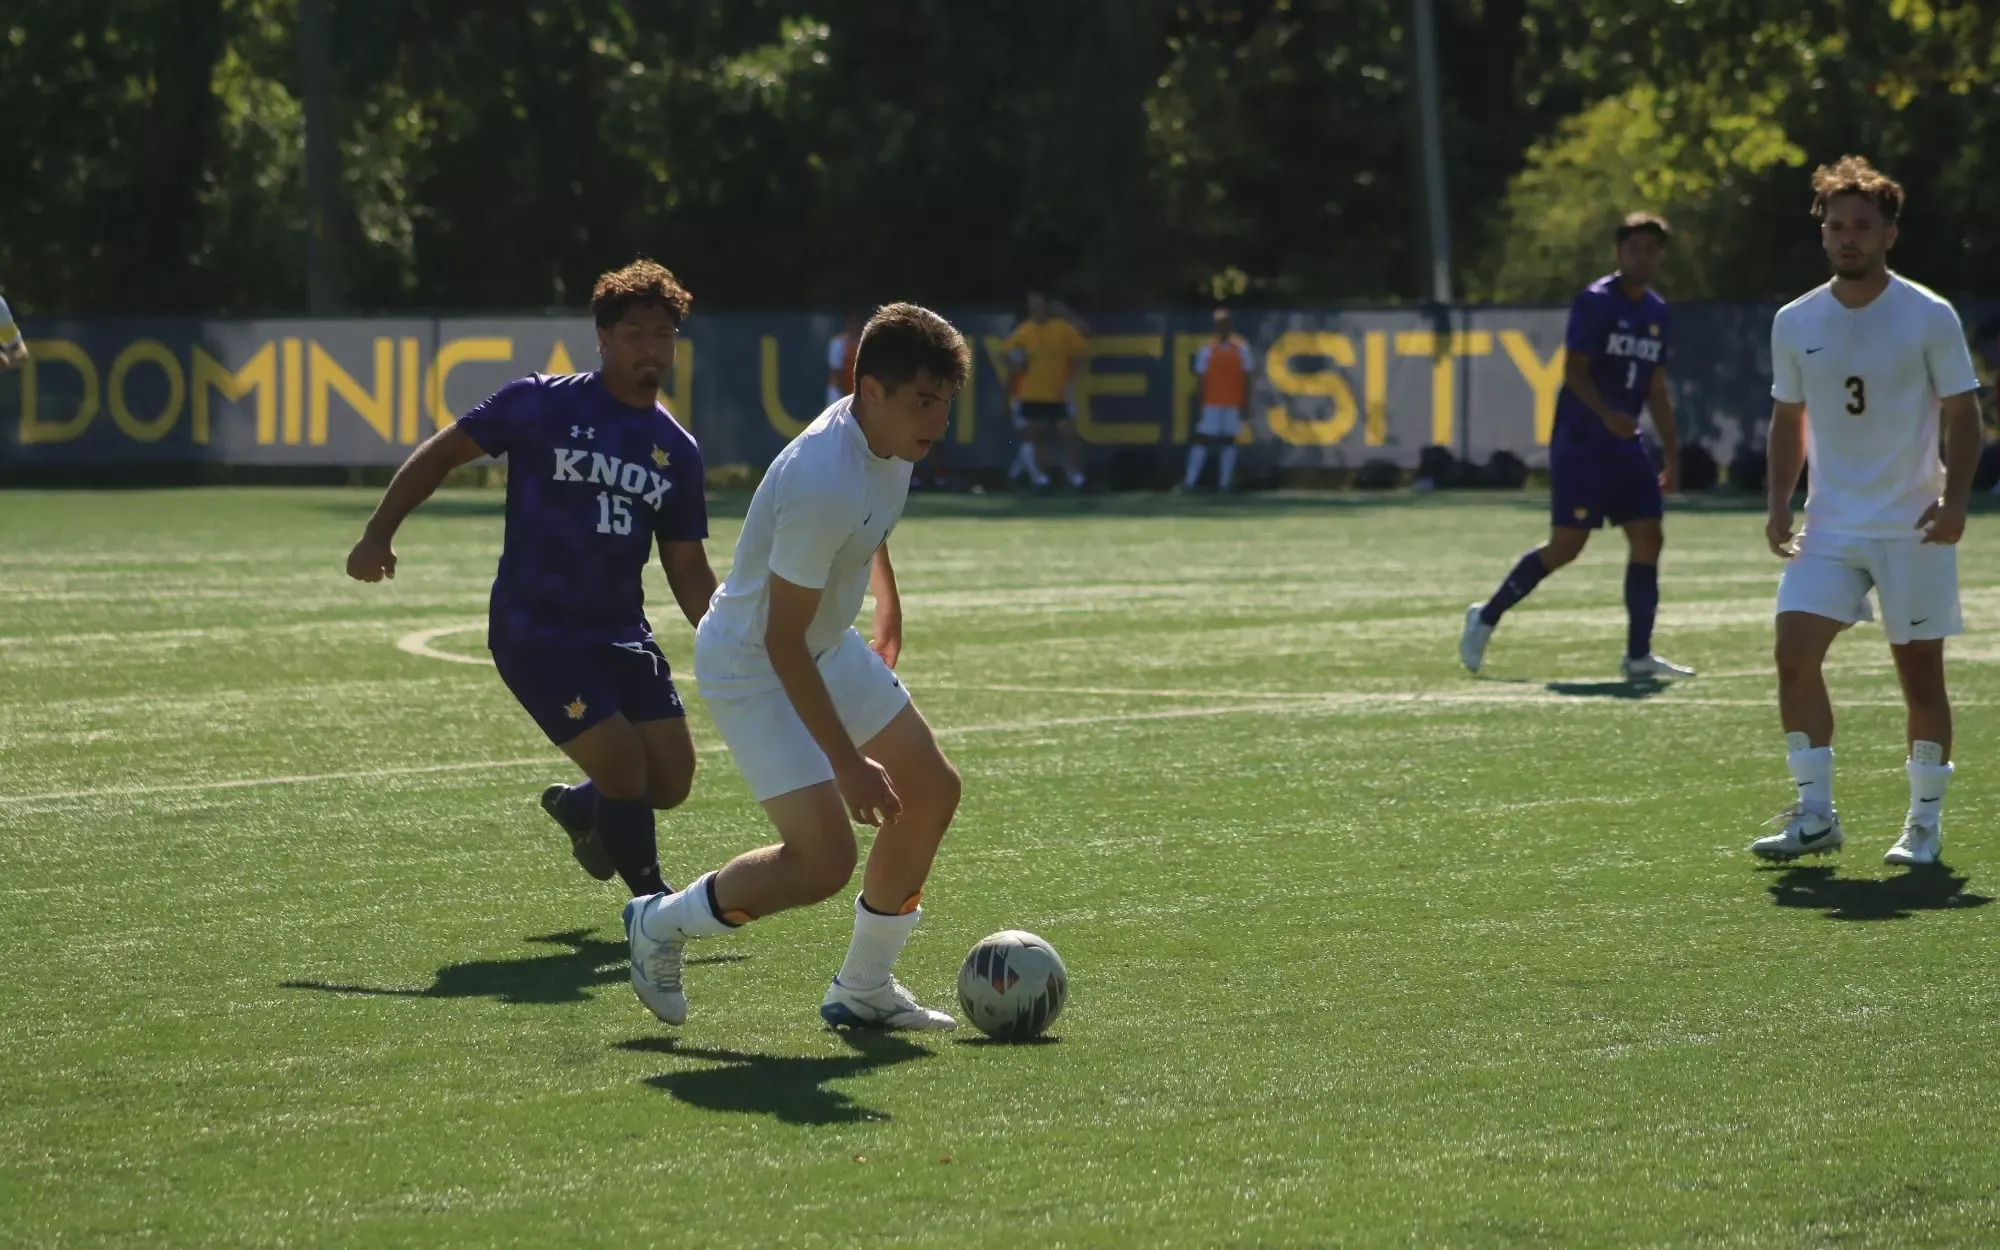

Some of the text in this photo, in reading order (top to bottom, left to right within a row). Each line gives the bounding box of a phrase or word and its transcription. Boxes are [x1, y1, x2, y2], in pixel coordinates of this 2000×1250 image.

[1605, 333, 1662, 363] KNOX
[761, 329, 1567, 445] UIESITY
[1626, 361, 1638, 389] 1
[1844, 376, 1865, 415] 3
[552, 448, 673, 512] KNOX
[596, 491, 633, 536] 15
